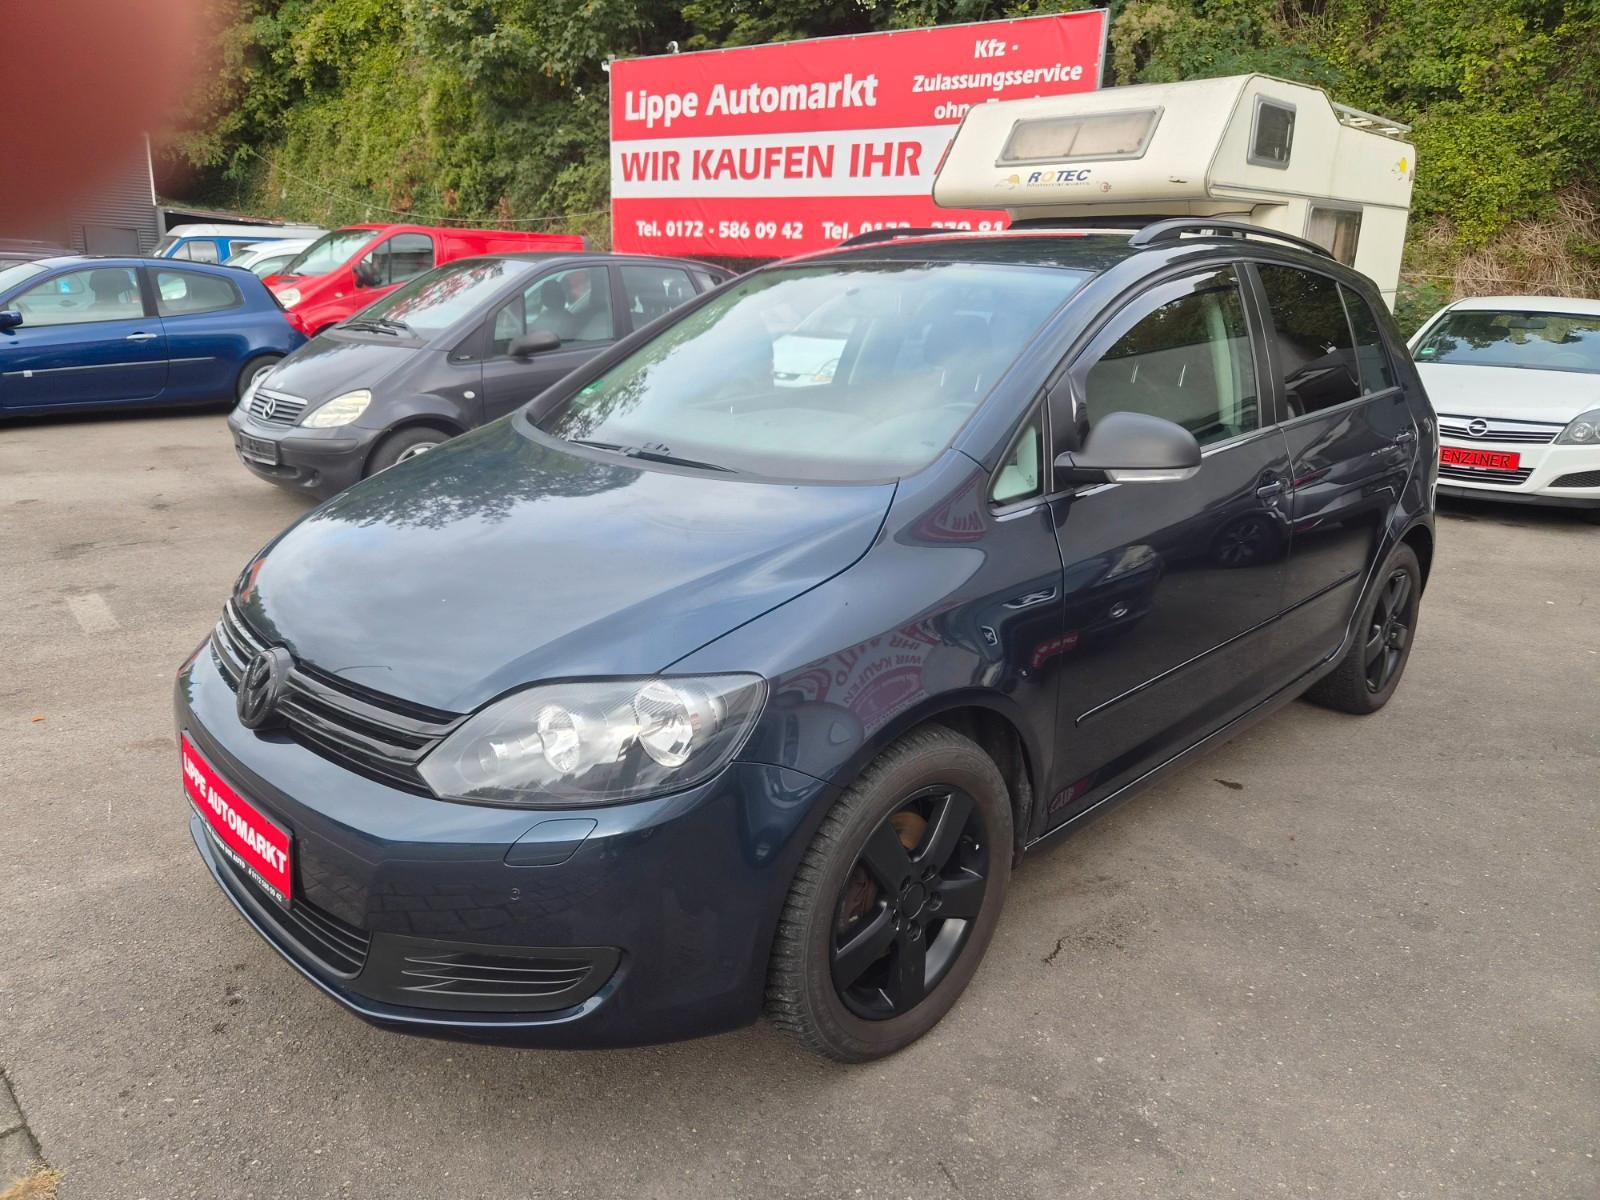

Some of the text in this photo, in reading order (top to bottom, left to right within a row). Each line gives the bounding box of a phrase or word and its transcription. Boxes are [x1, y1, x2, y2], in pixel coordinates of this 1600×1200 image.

[974, 39, 1006, 58] Kfz
[912, 63, 1083, 92] Zulassungsservice
[624, 73, 878, 129] Lippe Automarkt
[933, 101, 969, 120] ohn
[621, 150, 681, 182] WIR
[692, 144, 835, 181] KAUFEN
[849, 141, 922, 178] IHR
[1028, 169, 1092, 186] ROTEC
[635, 220, 662, 237] Tel.
[665, 220, 704, 238] 0172
[718, 221, 750, 239] 586
[755, 221, 777, 239] 09
[781, 221, 804, 240] 42
[1441, 449, 1512, 468] ENZINER
[183, 751, 207, 799] LIPPE
[208, 786, 287, 874] AUTOMARKT
